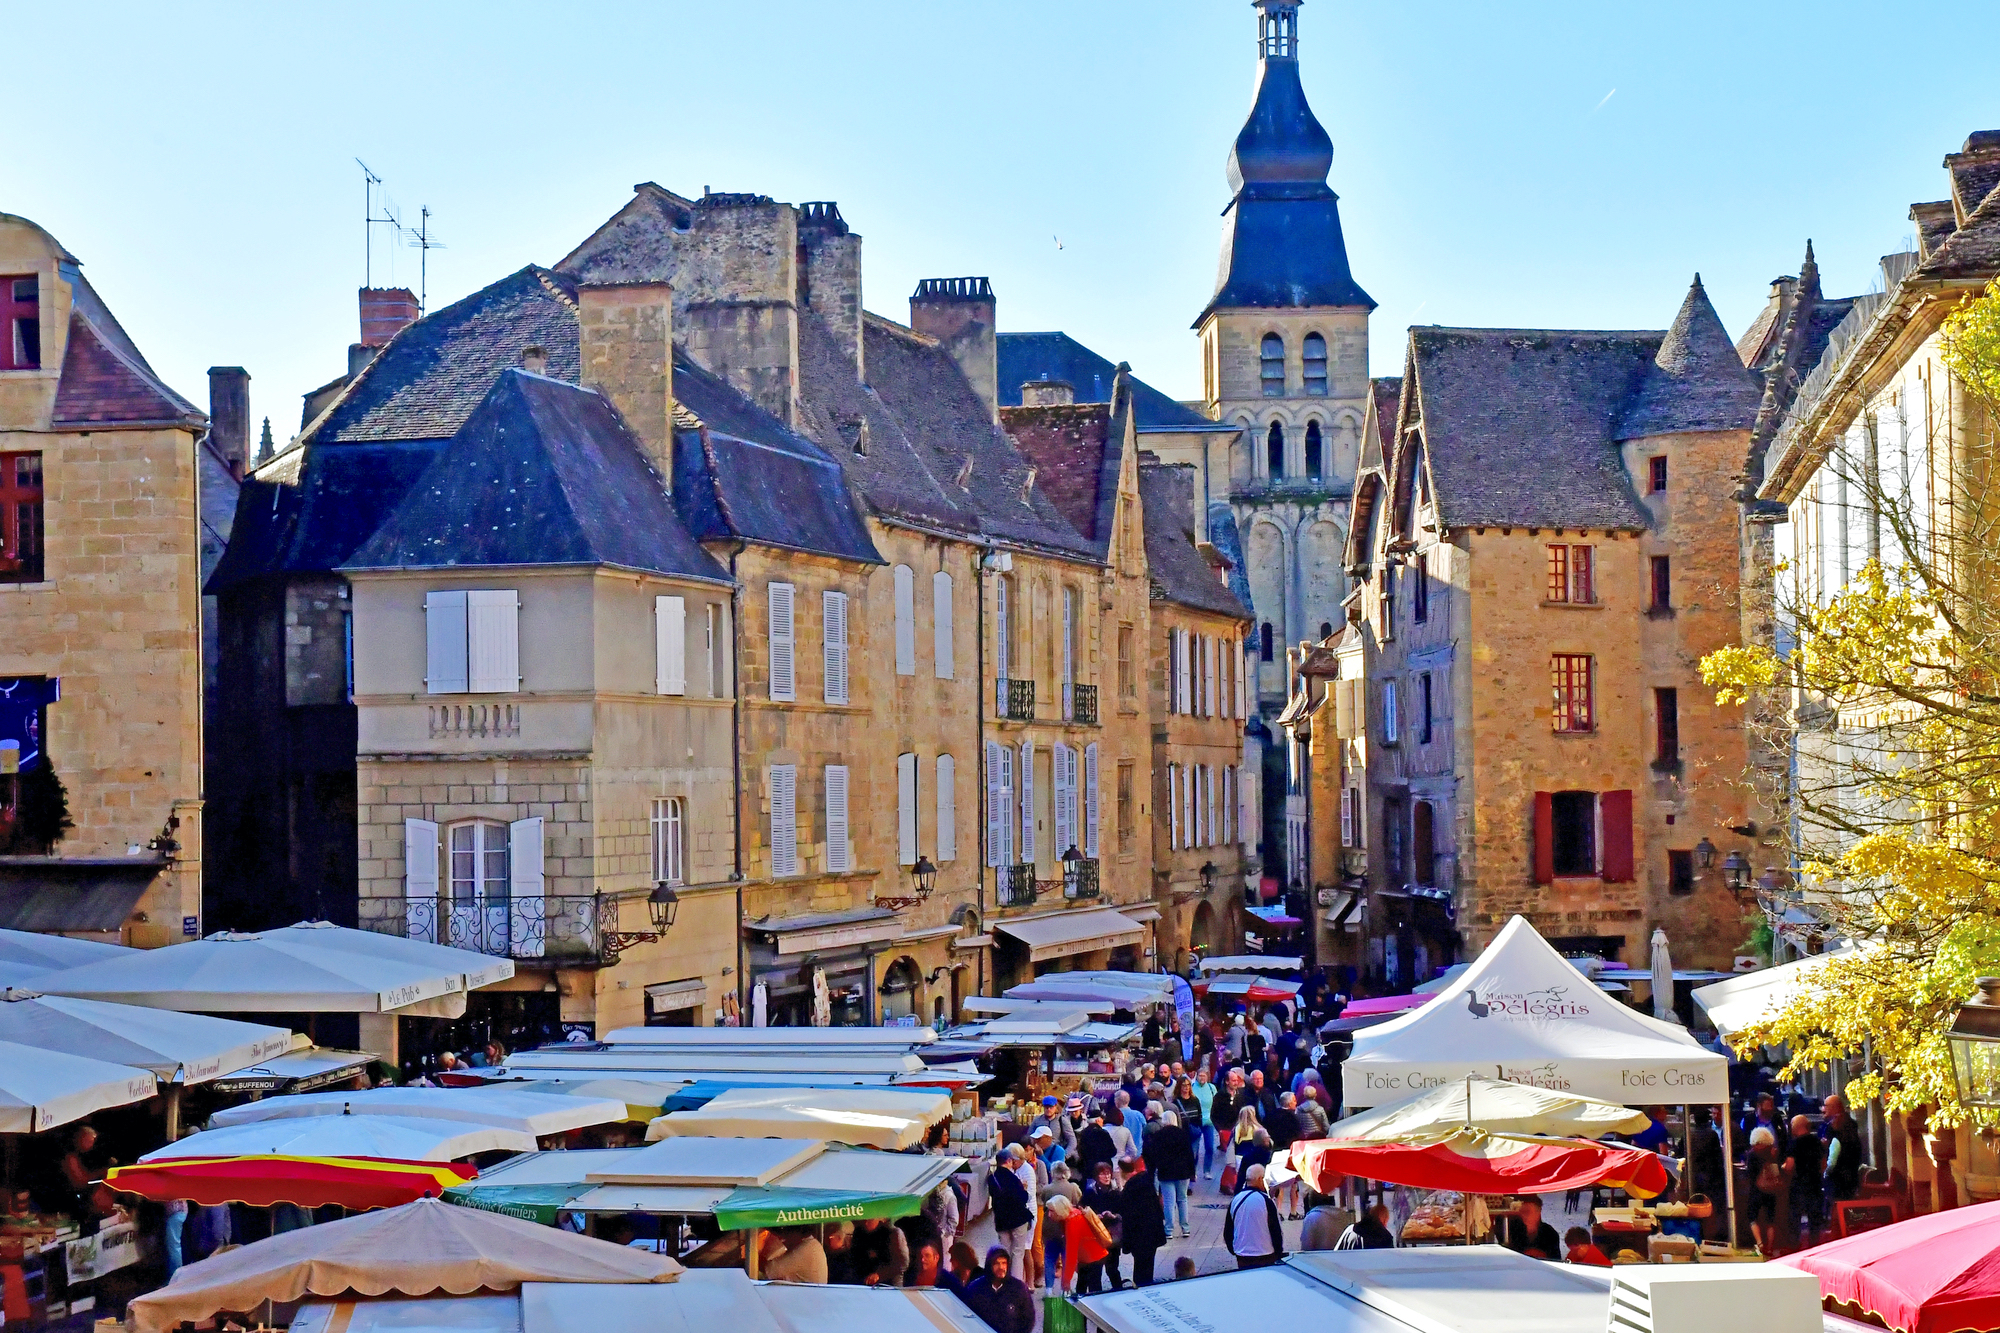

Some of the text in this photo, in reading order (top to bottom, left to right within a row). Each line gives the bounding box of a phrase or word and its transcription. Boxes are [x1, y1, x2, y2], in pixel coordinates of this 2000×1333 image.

[391, 986, 415, 1006] Le Pub
[1485, 992, 1524, 1000] Maison
[1487, 1000, 1590, 1020] Pélégris
[238, 1081, 275, 1090] BUFFENOU
[1366, 1071, 1447, 1089] Foie Gras
[1621, 1068, 1705, 1086] Foie Gras
[127, 1076, 156, 1098] Cocktail
[776, 1203, 864, 1222] Authenticité
